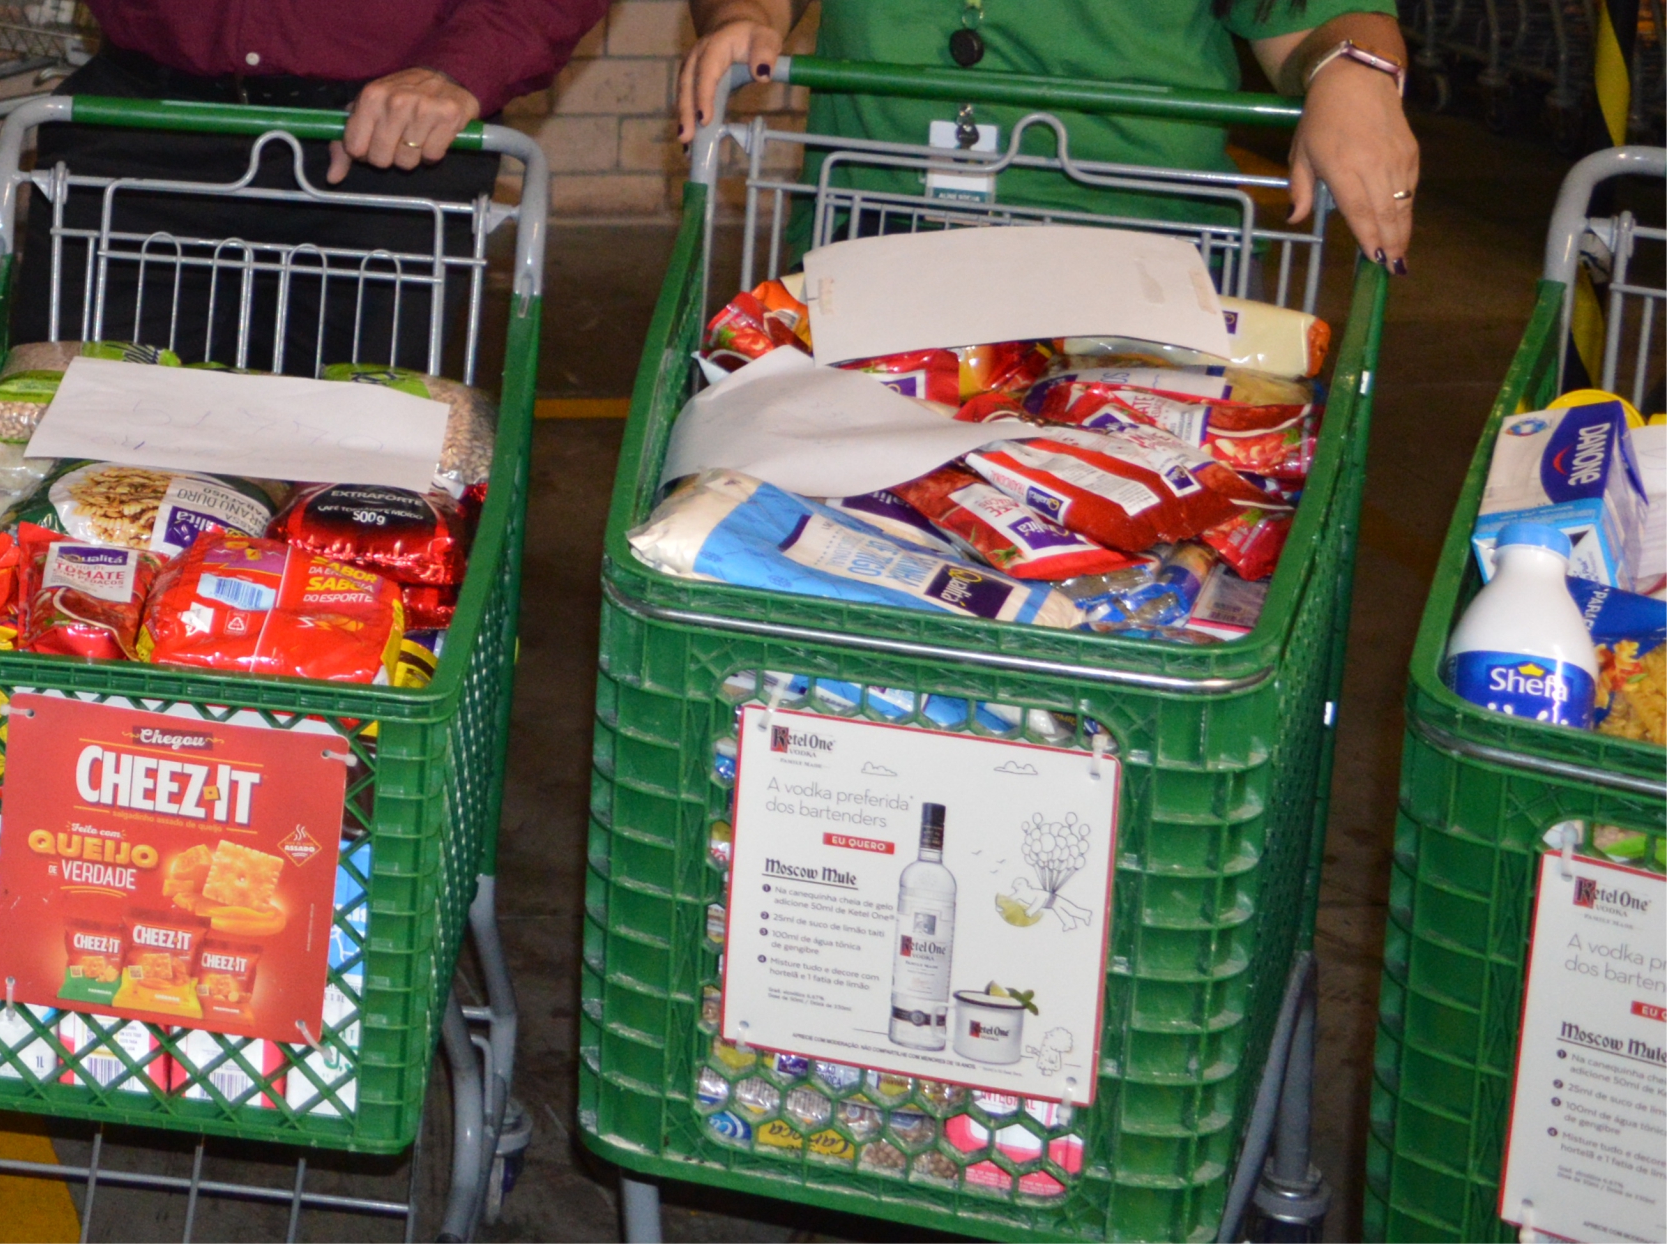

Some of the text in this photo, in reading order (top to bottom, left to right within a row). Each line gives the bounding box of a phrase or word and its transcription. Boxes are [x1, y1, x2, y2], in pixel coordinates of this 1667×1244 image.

[1567, 422, 1611, 487] DANONE
[177, 489, 218, 508] DURO
[331, 489, 423, 507] EXTRAFORTE
[56, 562, 126, 580] TOMATE
[303, 592, 374, 604] DO ESPORTE
[1489, 666, 1569, 703] Shefa
[138, 728, 207, 750] Chegou
[773, 727, 834, 751] Ketel One
[767, 776, 780, 792] A
[785, 781, 832, 800] vodka
[112, 809, 223, 833] salgadinho assado de queijo
[765, 797, 887, 828] dos bartenders
[71, 822, 122, 838] Feito com
[28, 829, 159, 868] QUEIJO
[831, 836, 886, 851] EU QUERO
[48, 859, 137, 890] DE VERDADE
[765, 857, 857, 886] Moscow Mule
[774, 898, 809, 909] adicione
[789, 890, 861, 906] canequinha cheia
[1576, 878, 1648, 912] Ketel One
[809, 920, 828, 929] suco
[842, 924, 867, 935] limão
[1567, 933, 1644, 966] A vodka
[770, 957, 822, 973] Misture tudo
[1564, 955, 1599, 977] dos
[1641, 1005, 1658, 1017] EU
[1561, 1020, 1667, 1063] Moscow Mule
